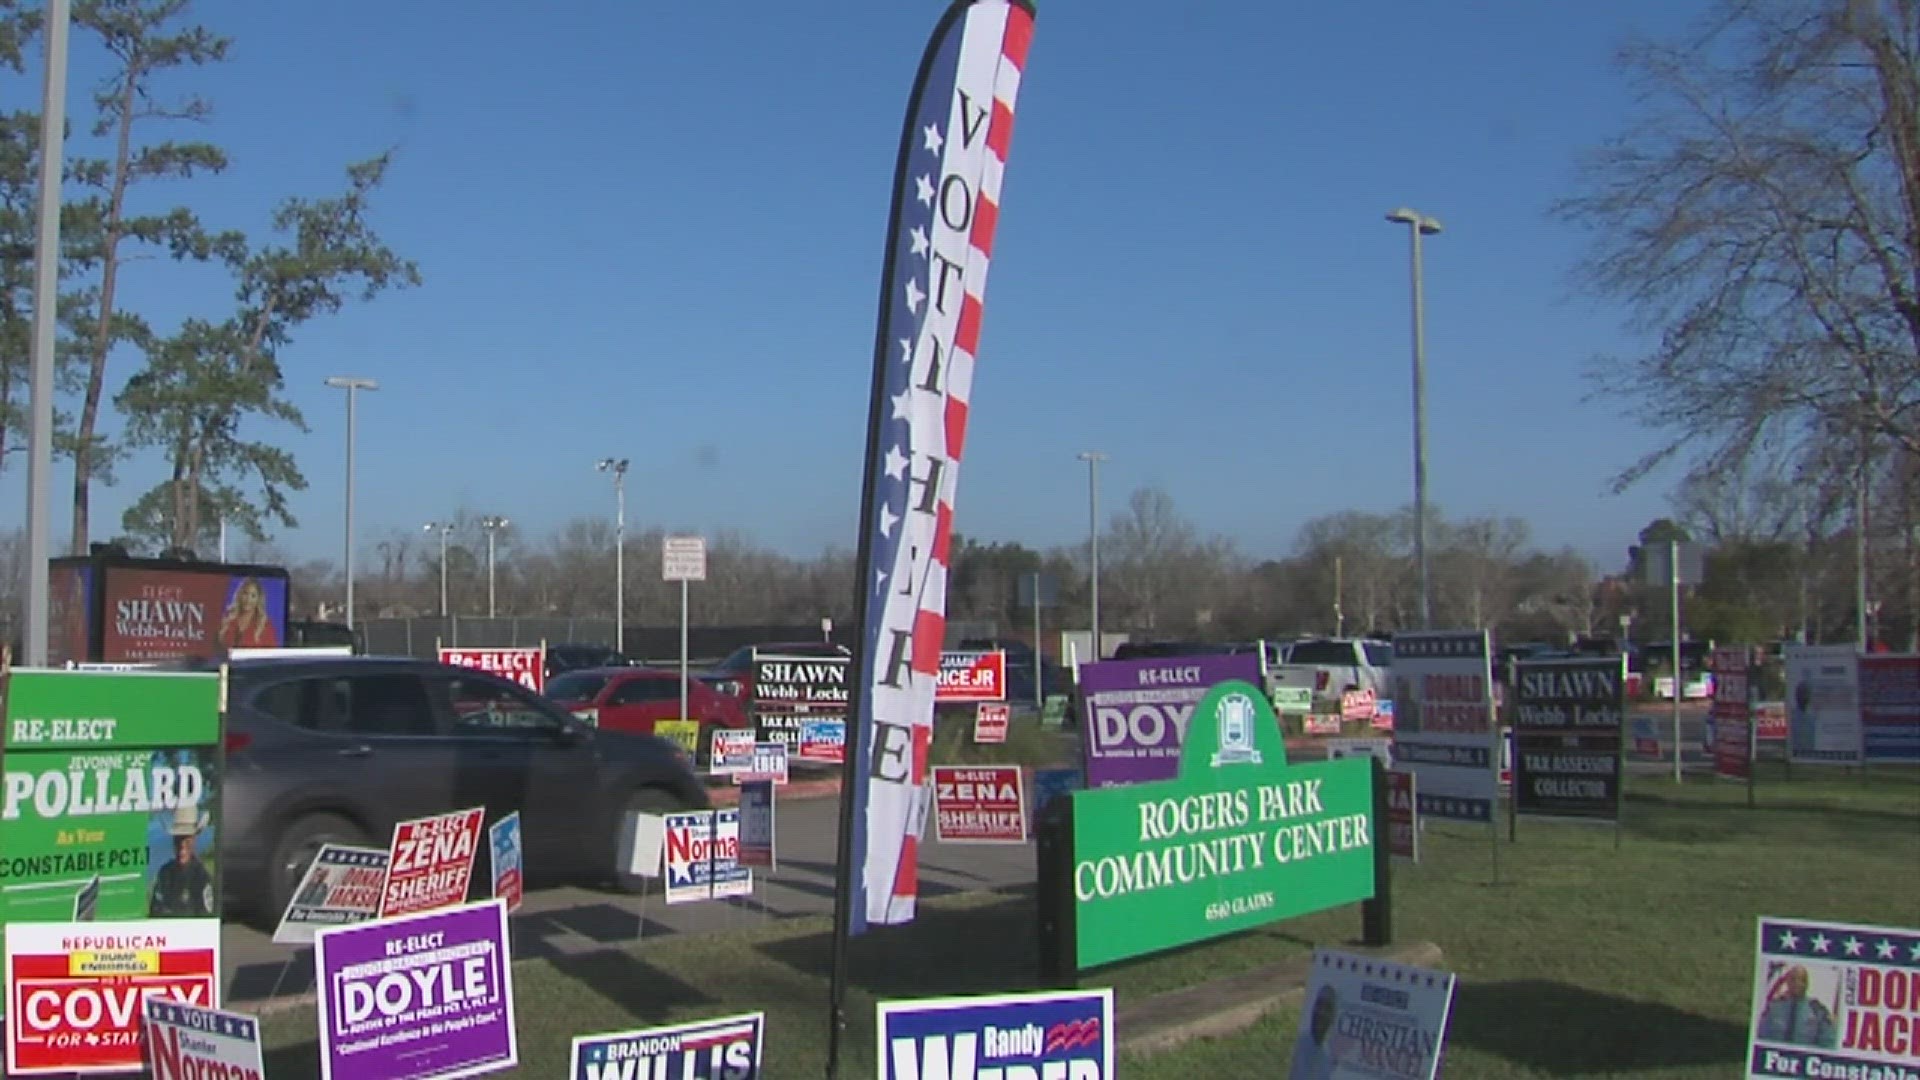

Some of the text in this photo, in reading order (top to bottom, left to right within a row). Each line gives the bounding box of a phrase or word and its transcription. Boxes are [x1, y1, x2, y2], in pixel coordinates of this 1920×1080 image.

[117, 600, 204, 624] SHAWN
[116, 621, 205, 641] Webb-Locke
[761, 664, 845, 683] SHAWN
[972, 669, 994, 686] JR
[1138, 666, 1200, 685] RE-ELECT
[1522, 671, 1615, 698] SHAWN
[757, 684, 798, 698] Webb
[1097, 704, 1195, 746] DOY
[1518, 705, 1620, 725] Webb Locke
[12, 719, 117, 742] RE-ELECT
[3, 766, 202, 819] POLLARD
[938, 784, 1017, 800] ZENA
[1139, 778, 1324, 842] ROGERS PARK
[392, 829, 472, 873] ZENA
[668, 828, 739, 863] Norma
[1075, 813, 1370, 901] COMMUNITY CENTER
[0, 850, 102, 878] CONSTABLE
[386, 866, 468, 902] SHERIFF
[62, 935, 167, 950] REPUBLICAN
[385, 933, 444, 956] RE-ELECT
[94, 953, 137, 962] TRUMP
[344, 957, 488, 1025] DOYLE
[181, 1008, 218, 1032] VOTE
[46, 1032, 81, 1049] FOR
[607, 1036, 680, 1061] BRANDON
[984, 1022, 1044, 1058] Randy
[1765, 1050, 1801, 1074] For
